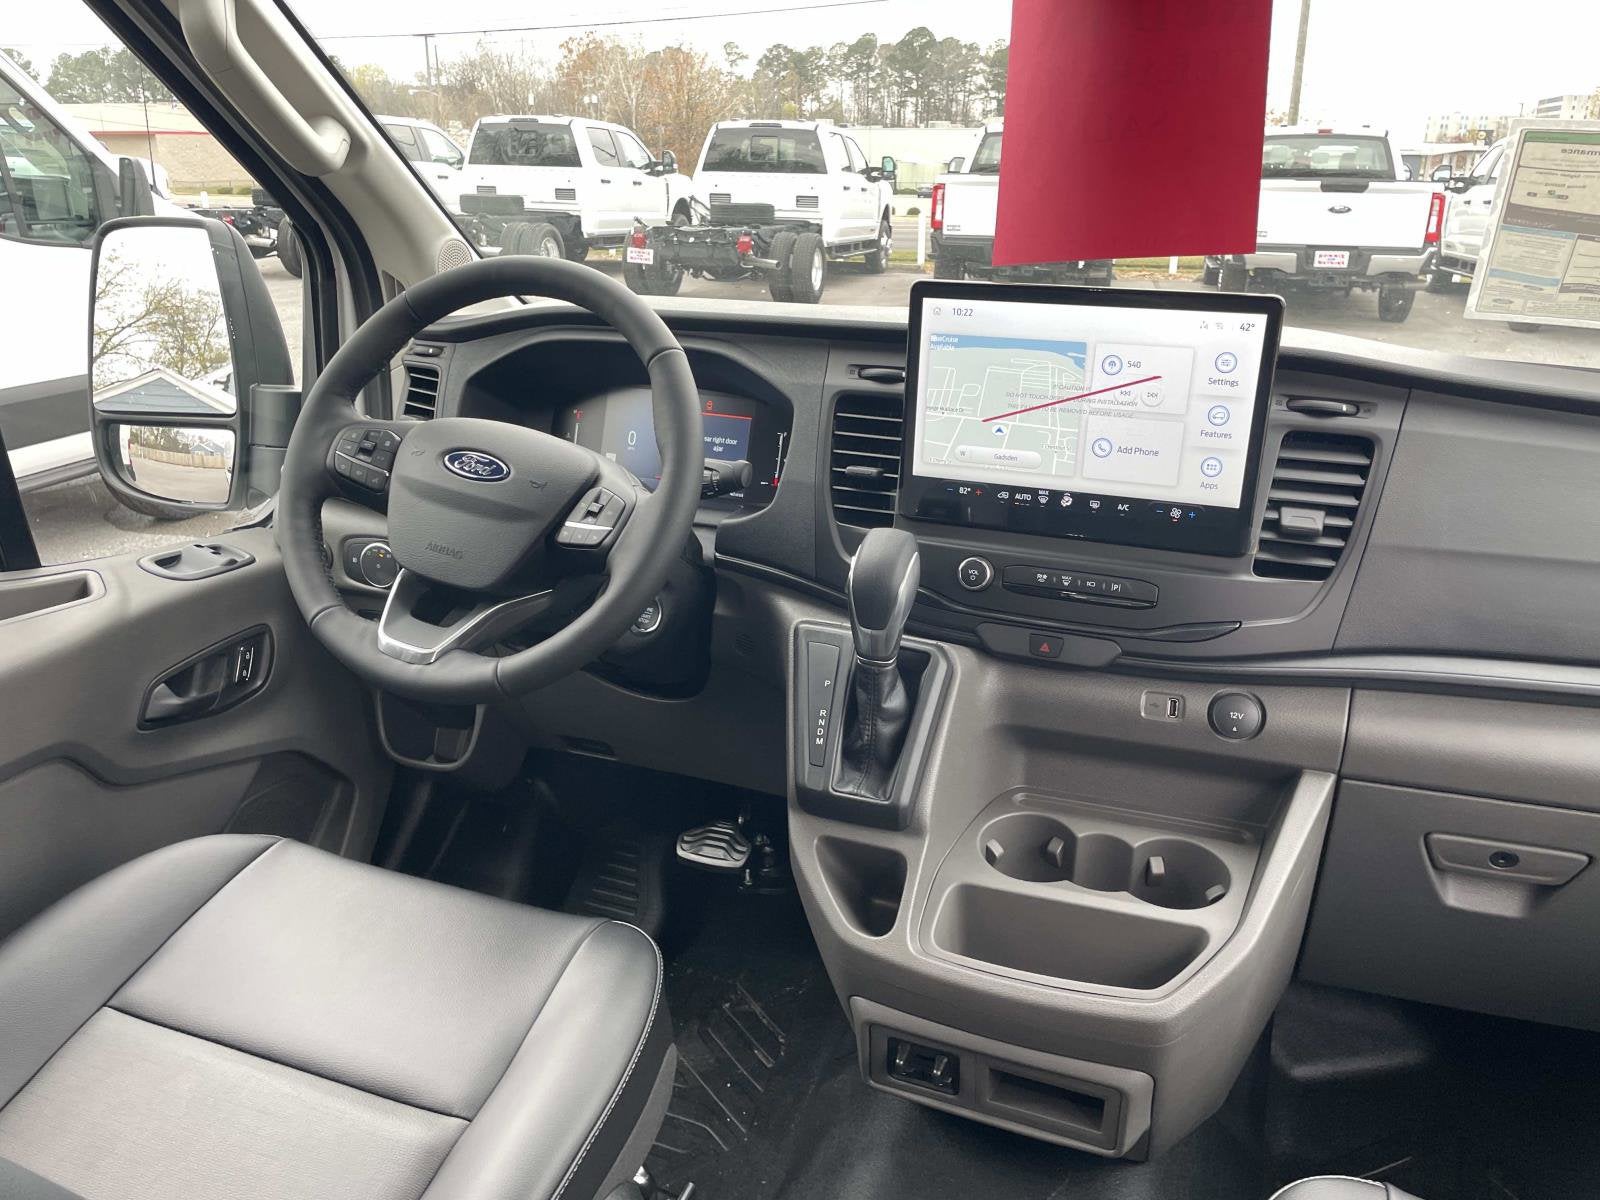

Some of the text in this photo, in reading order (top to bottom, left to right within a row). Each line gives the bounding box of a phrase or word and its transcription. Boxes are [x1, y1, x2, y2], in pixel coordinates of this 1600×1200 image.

[952, 307, 973, 317] 10:22
[1207, 377, 1239, 388] Settings
[627, 430, 637, 446] 0
[1200, 430, 1233, 440] Features
[713, 436, 725, 445] right
[1117, 446, 1159, 457] Add Phone
[993, 453, 1019, 462] Gadsden
[454, 454, 497, 476] Ford
[1200, 481, 1218, 492] Apps
[1015, 493, 1032, 501] AUTO
[1117, 503, 1130, 511] A/C
[824, 679, 831, 687] P
[819, 709, 827, 717] R
[1229, 711, 1245, 720] 12V
[818, 718, 825, 726] N
[816, 727, 824, 736] D
[815, 737, 824, 745] M
